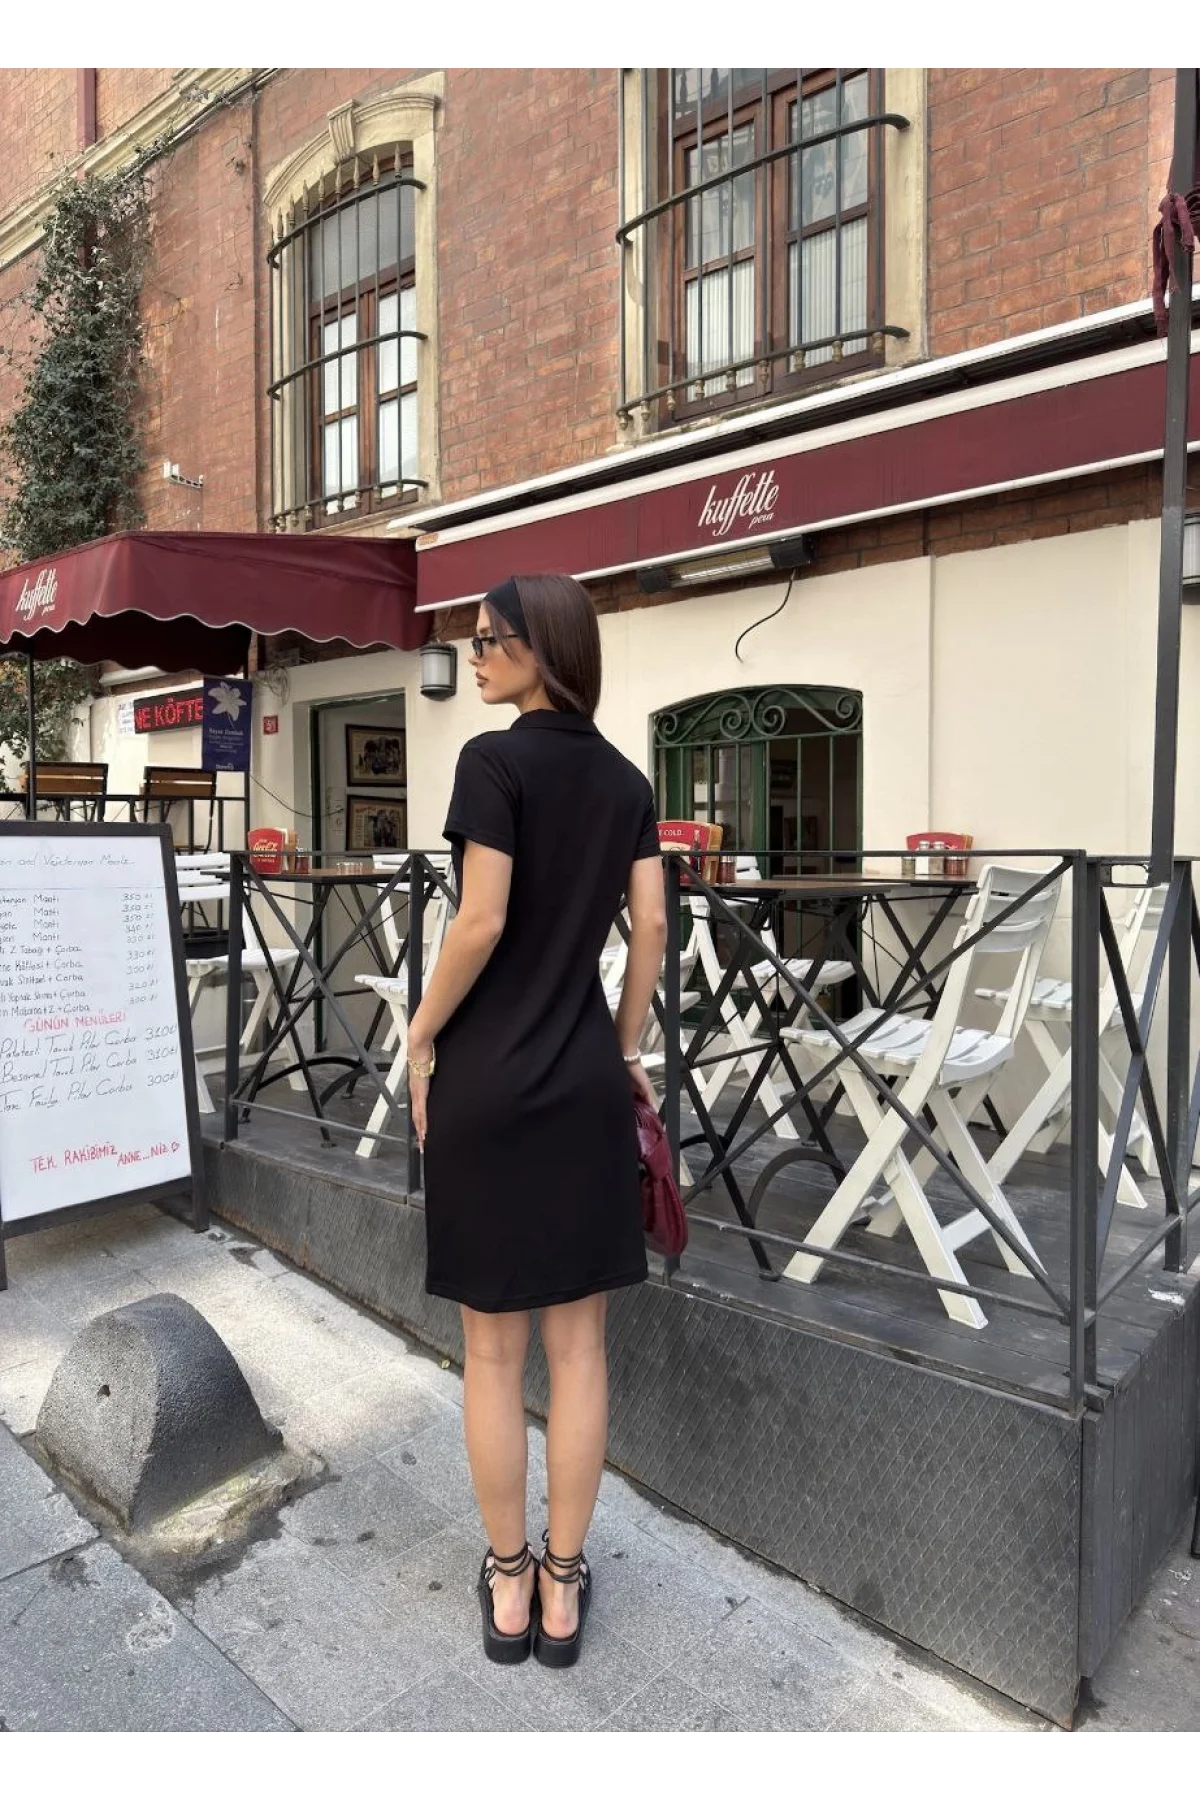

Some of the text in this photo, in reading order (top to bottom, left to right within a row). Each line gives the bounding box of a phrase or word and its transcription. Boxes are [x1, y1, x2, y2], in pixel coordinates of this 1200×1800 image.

[698, 470, 779, 536] kuffette
[15, 568, 58, 621] kuffette
[31, 1155, 57, 1173] TEK
